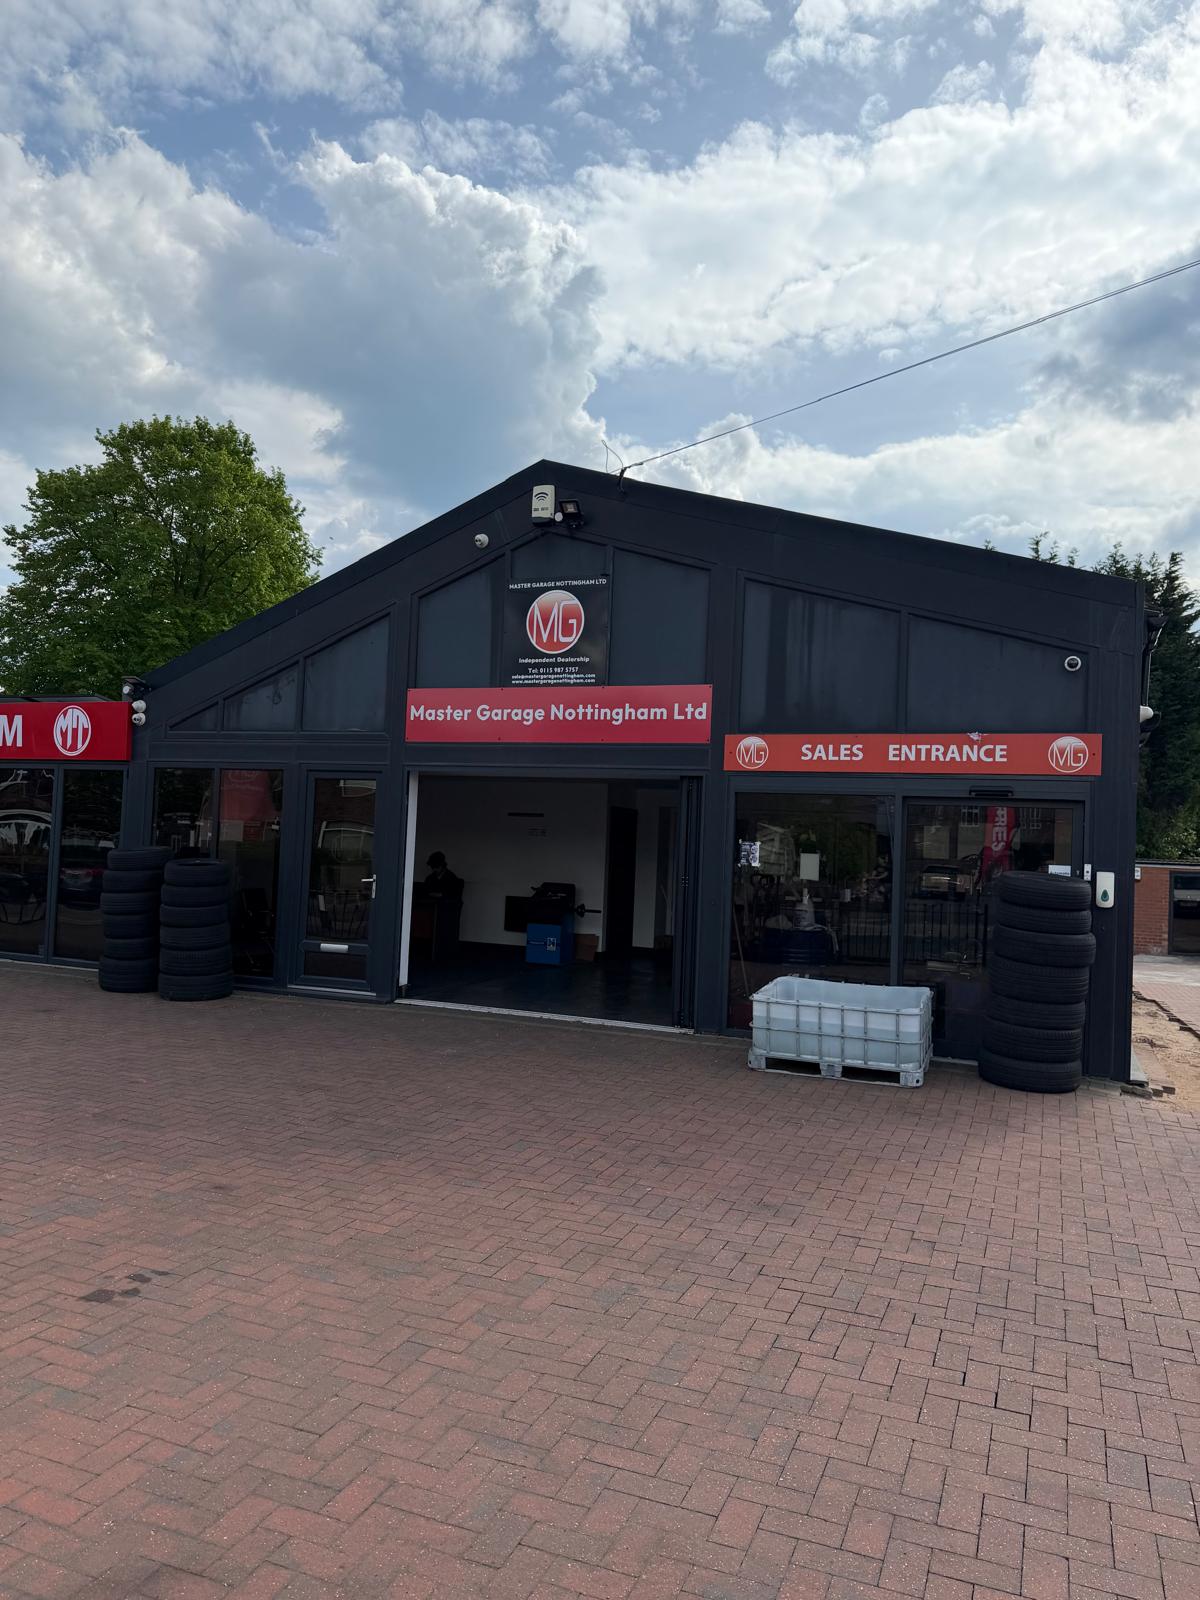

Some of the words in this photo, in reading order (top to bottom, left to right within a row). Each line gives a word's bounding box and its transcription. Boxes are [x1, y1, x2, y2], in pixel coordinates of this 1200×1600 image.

[556, 579, 595, 587] NOTTINGHAM
[531, 598, 580, 646] MG
[410, 704, 471, 722] Master
[476, 704, 544, 725] Garage
[550, 703, 668, 725] Nottingham
[674, 702, 707, 721] Ltd
[738, 742, 768, 767] MG
[800, 744, 864, 762] SALES
[888, 744, 1008, 763] ENTRANCE
[1050, 741, 1087, 769] MG
